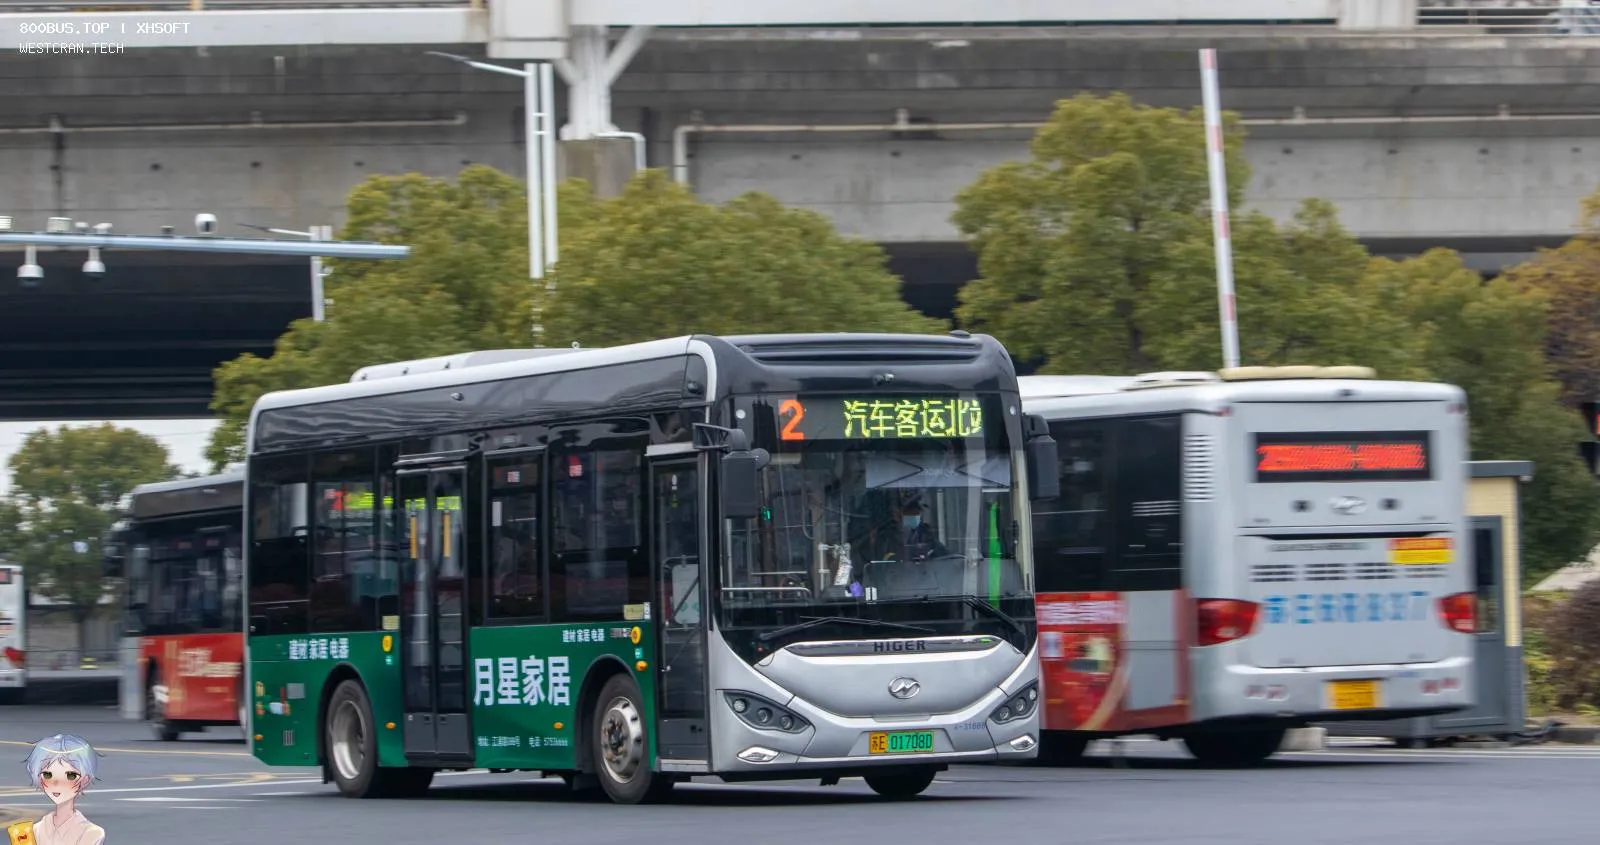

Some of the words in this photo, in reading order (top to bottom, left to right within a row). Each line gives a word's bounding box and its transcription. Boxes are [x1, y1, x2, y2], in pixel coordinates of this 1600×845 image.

[779, 400, 806, 440] 2
[309, 638, 328, 660] 家居
[873, 640, 926, 652] HIGER
[474, 655, 571, 706] 月星家居
